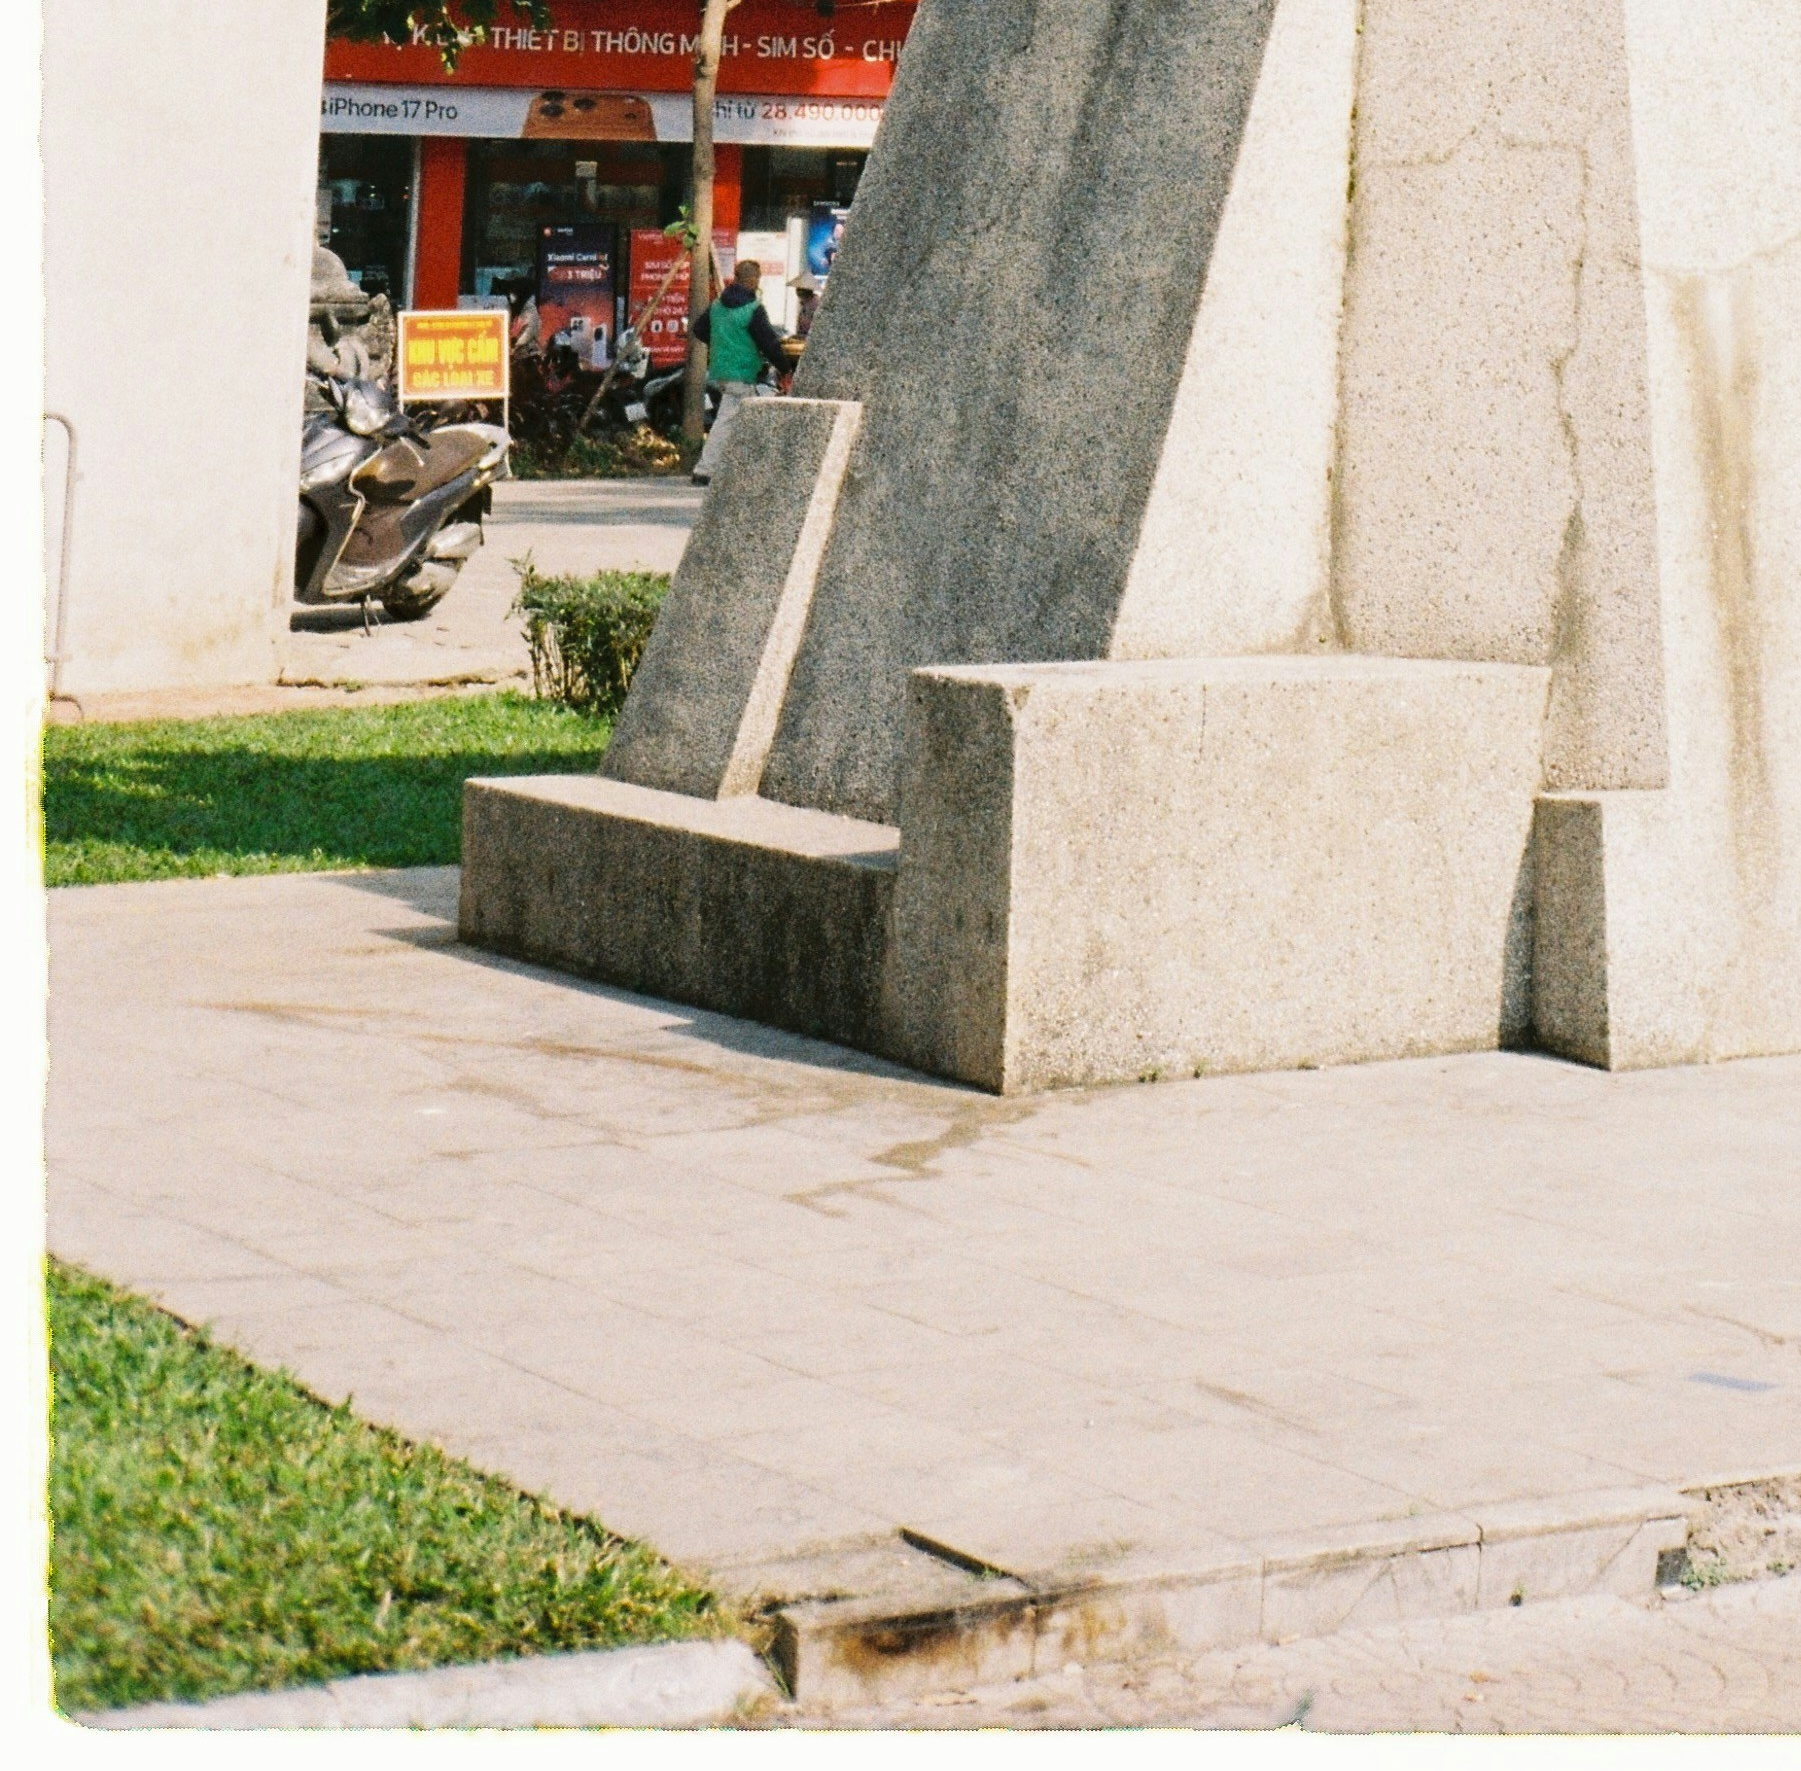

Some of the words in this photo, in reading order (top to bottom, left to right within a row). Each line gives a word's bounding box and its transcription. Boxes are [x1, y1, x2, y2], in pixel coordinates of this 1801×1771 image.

[591, 26, 674, 55] THÔNG
[680, 33, 739, 56] MH
[757, 36, 796, 58] SIM
[803, 28, 834, 59] SỐ
[329, 97, 398, 118] iPhone
[401, 100, 421, 118] 17
[425, 100, 458, 119] Pro
